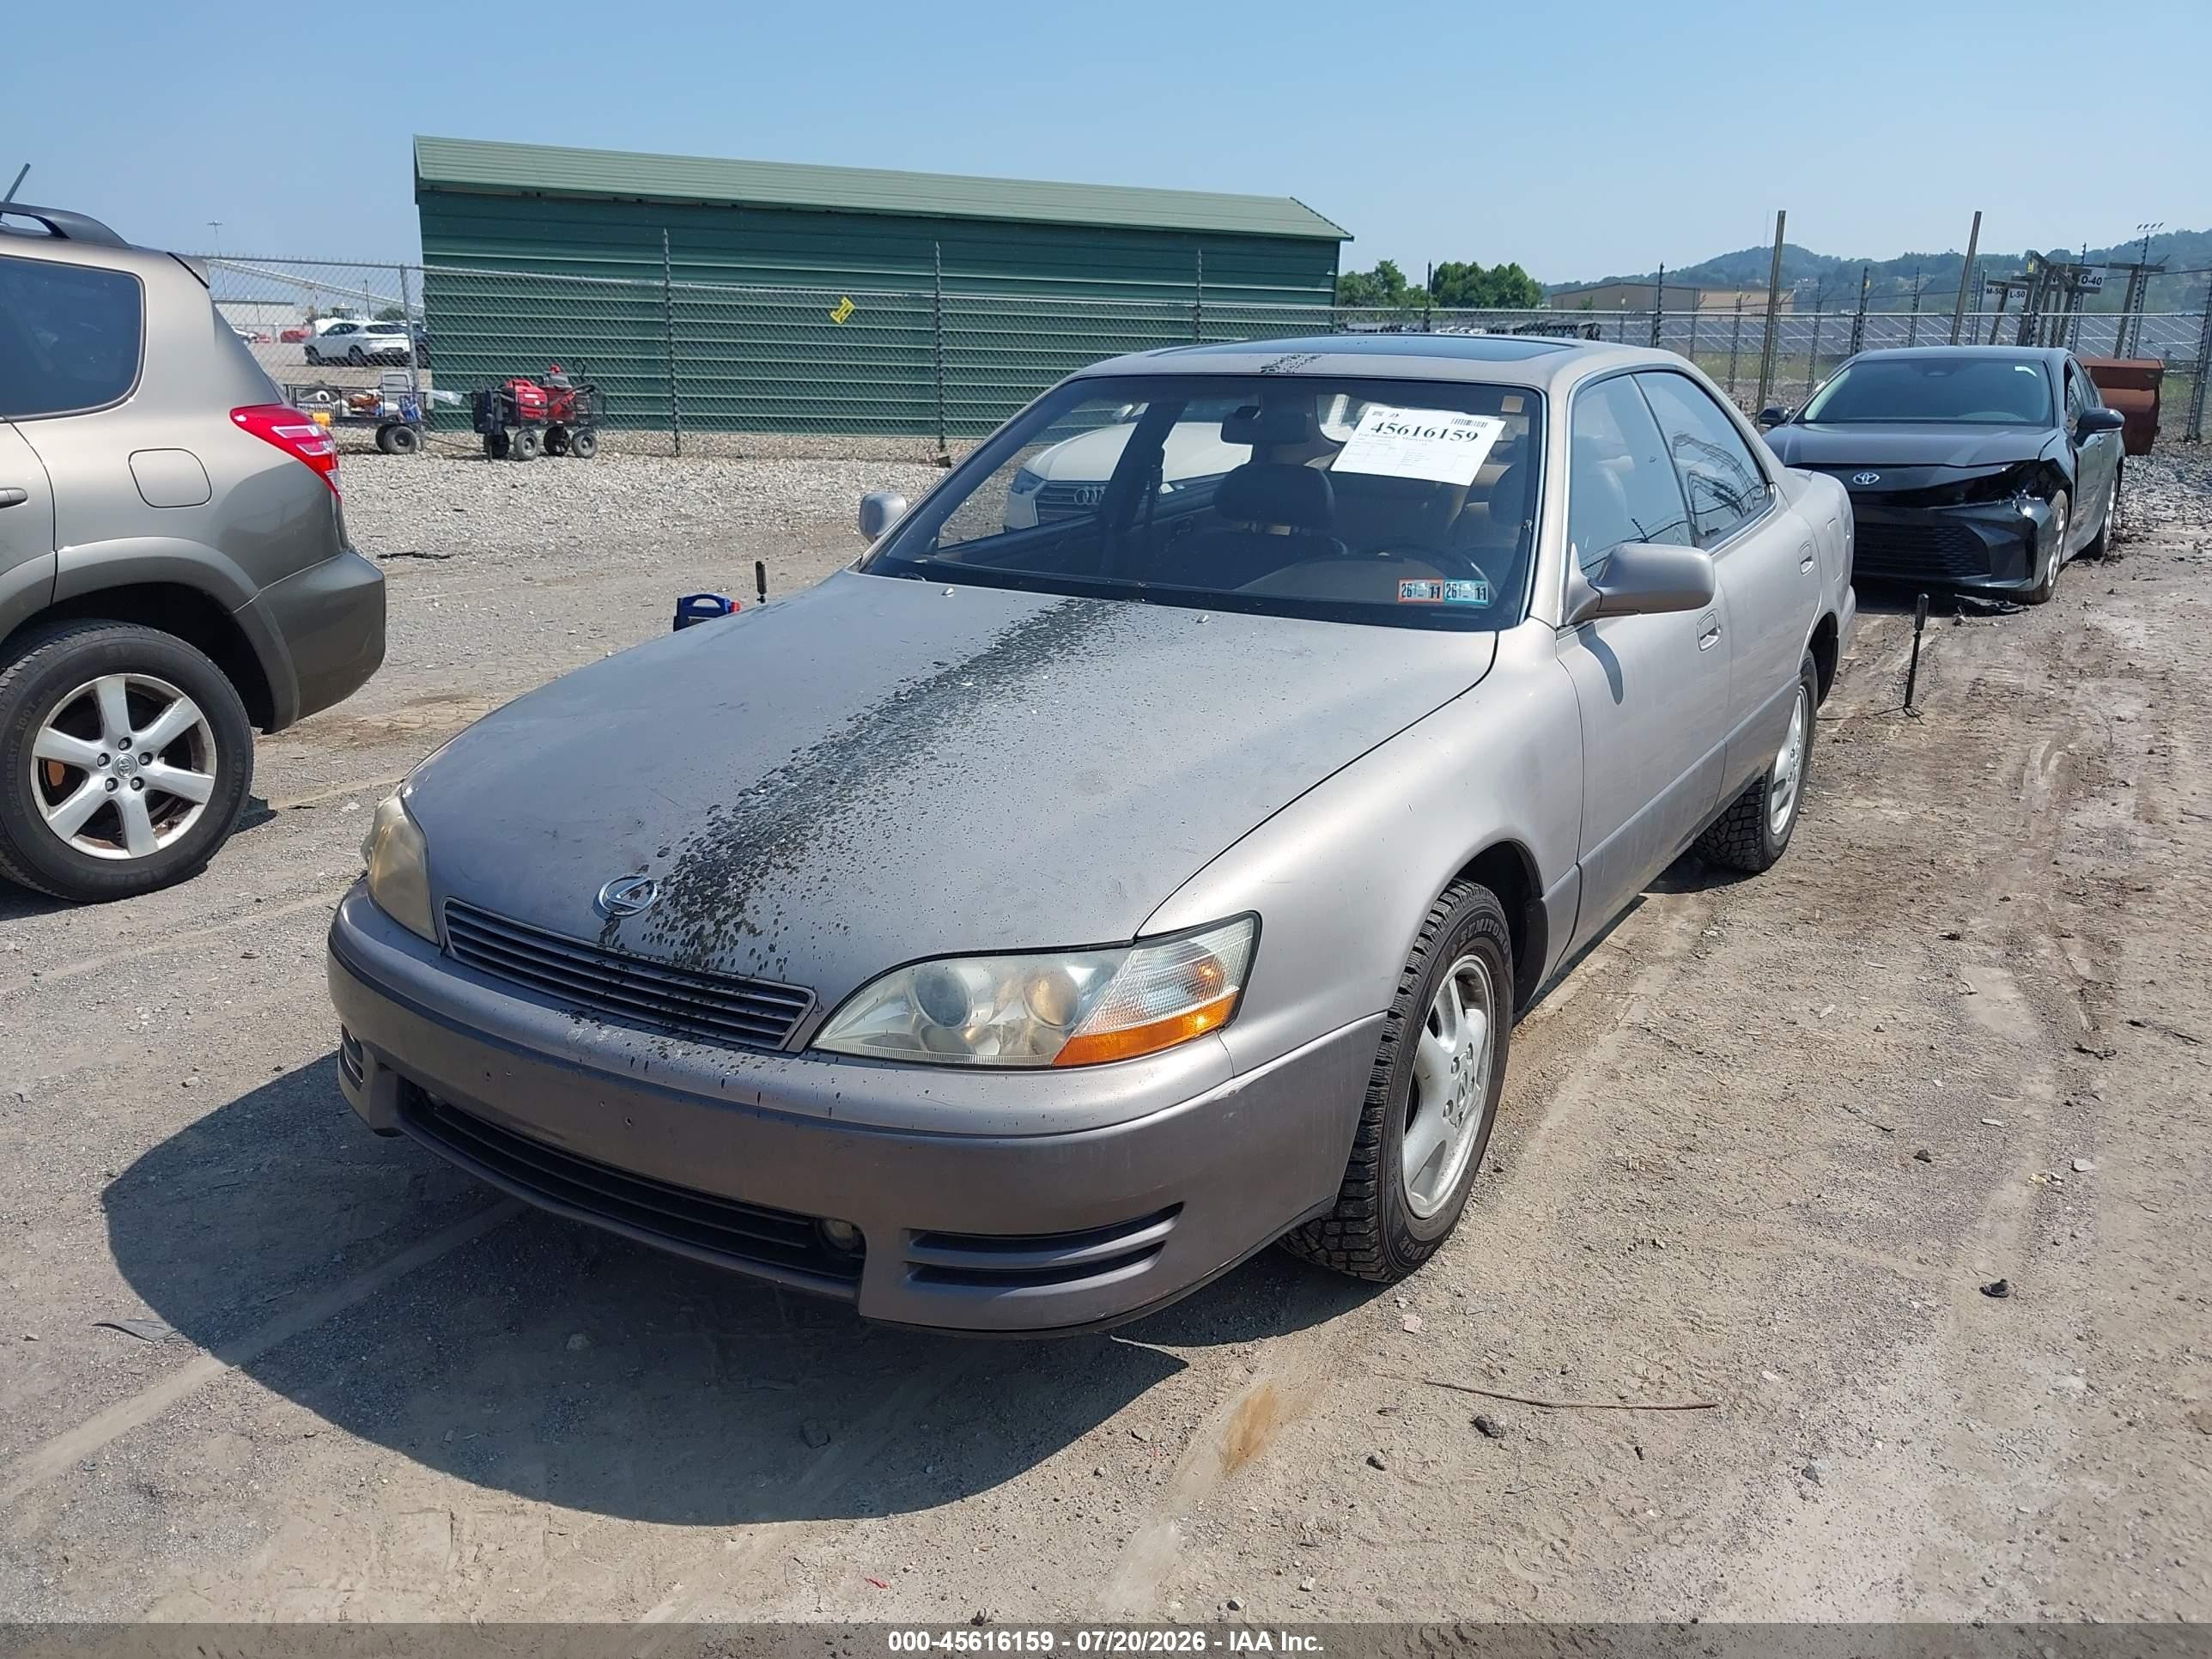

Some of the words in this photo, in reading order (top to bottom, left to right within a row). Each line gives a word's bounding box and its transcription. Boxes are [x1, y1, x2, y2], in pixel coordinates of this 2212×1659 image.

[1371, 421, 1479, 442] 45616159
[1401, 583, 1413, 598] 26
[1429, 586, 1440, 599] 11
[1446, 583, 1457, 598] 26
[1475, 586, 1486, 600] 11
[1459, 918, 1509, 954] SUMITOMO
